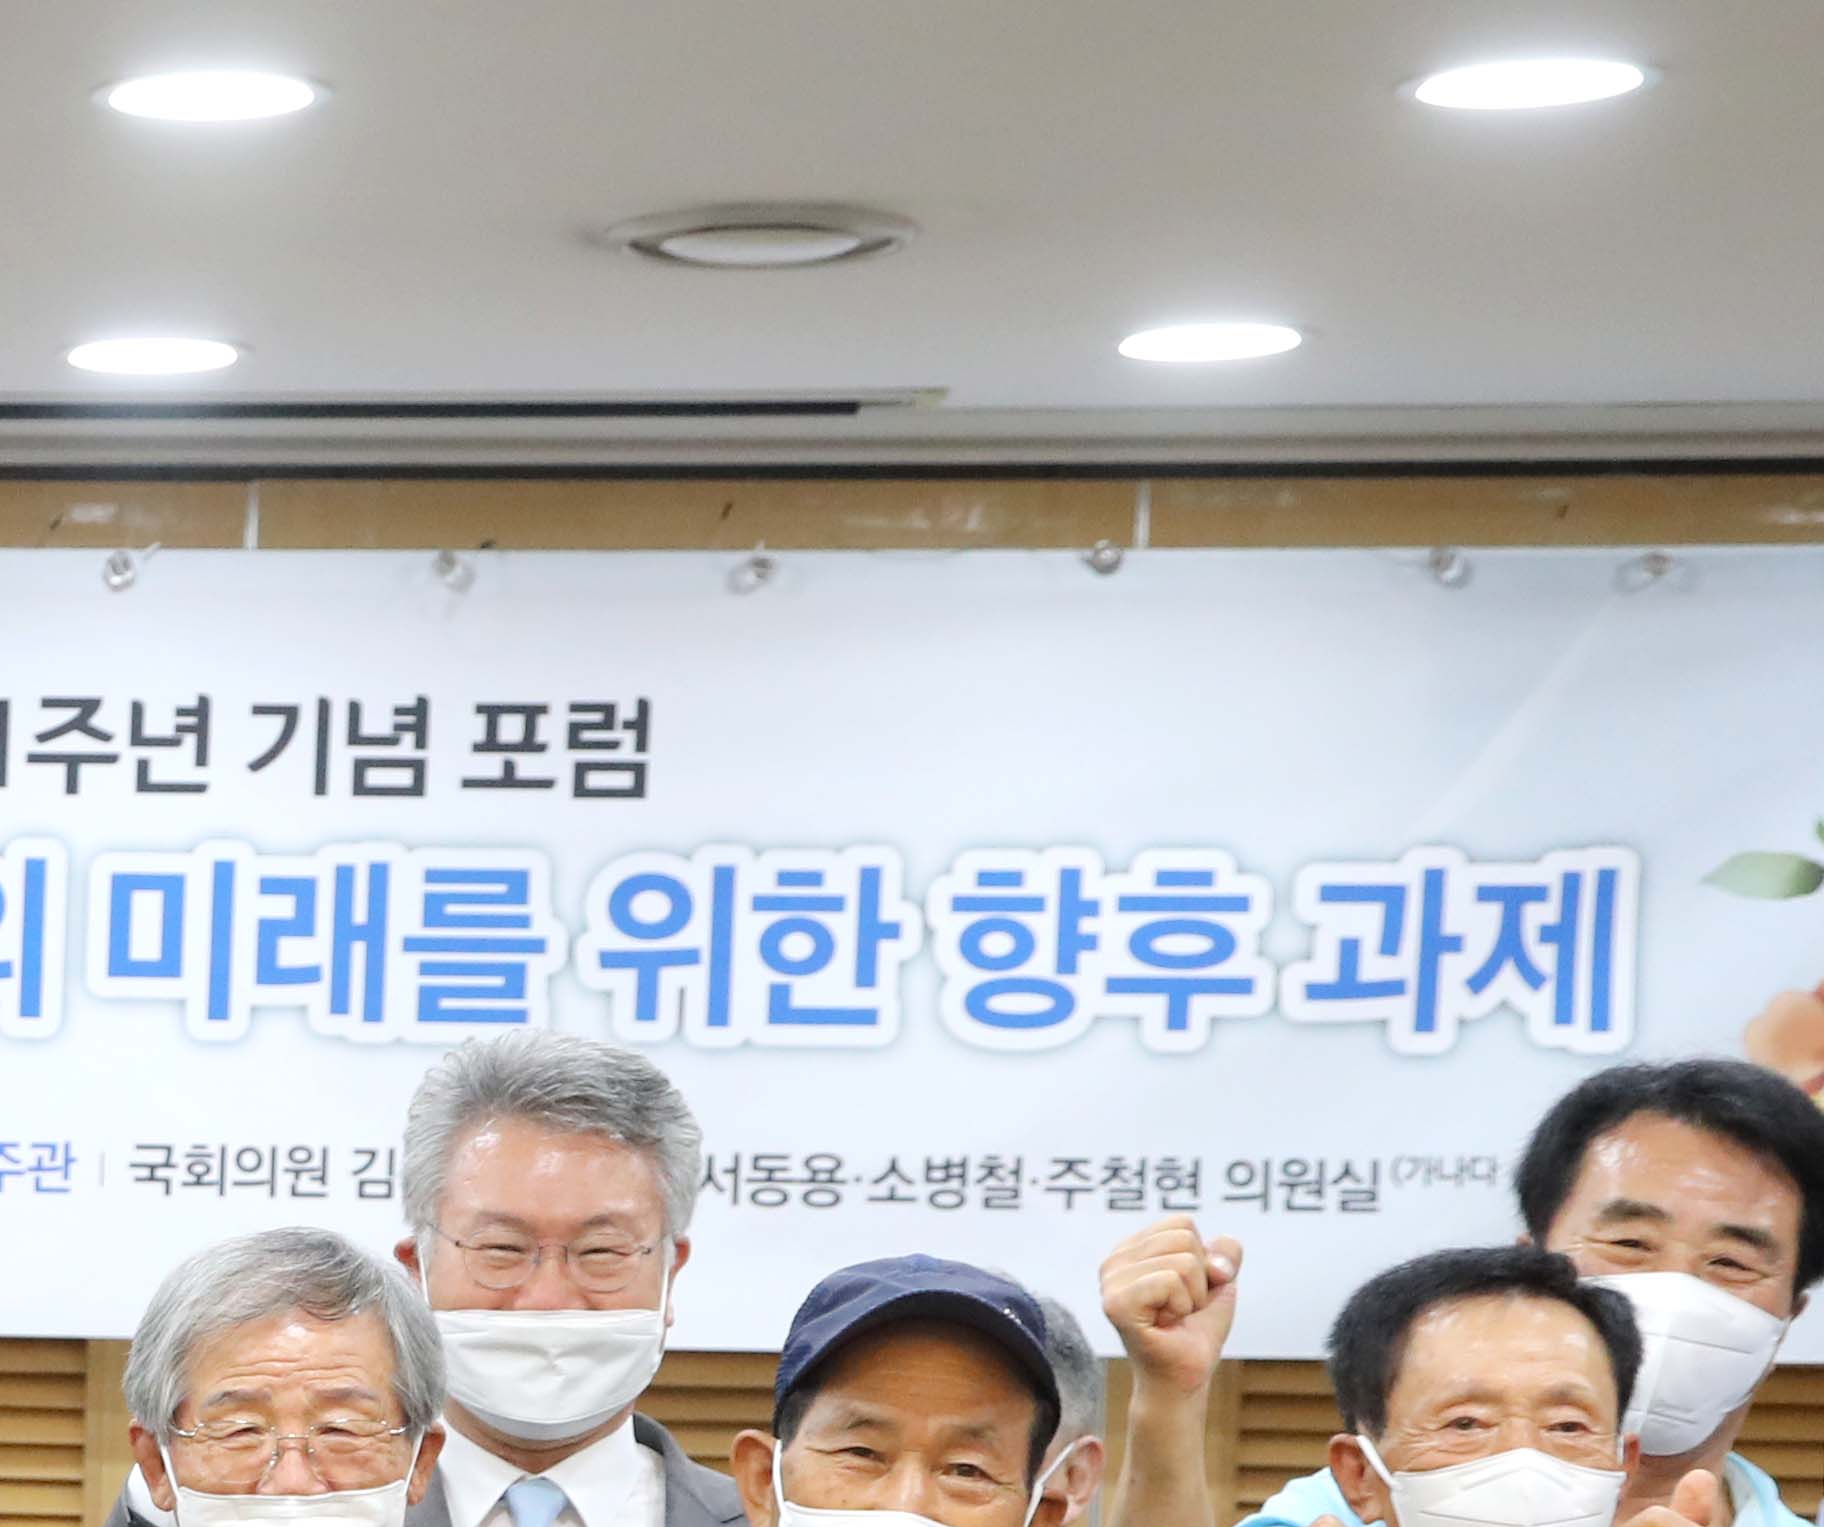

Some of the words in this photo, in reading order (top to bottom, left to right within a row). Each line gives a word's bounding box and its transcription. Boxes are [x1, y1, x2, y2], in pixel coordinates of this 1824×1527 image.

[247, 694, 431, 798] 기념
[460, 697, 651, 799] 포럼
[108, 859, 547, 1024] 미래를
[598, 864, 901, 1028] 위한
[951, 867, 1255, 1032] 향후
[1305, 867, 1619, 1034] 과제
[129, 1144, 329, 1199] 국회의원
[1222, 1157, 1380, 1214] 의원실
